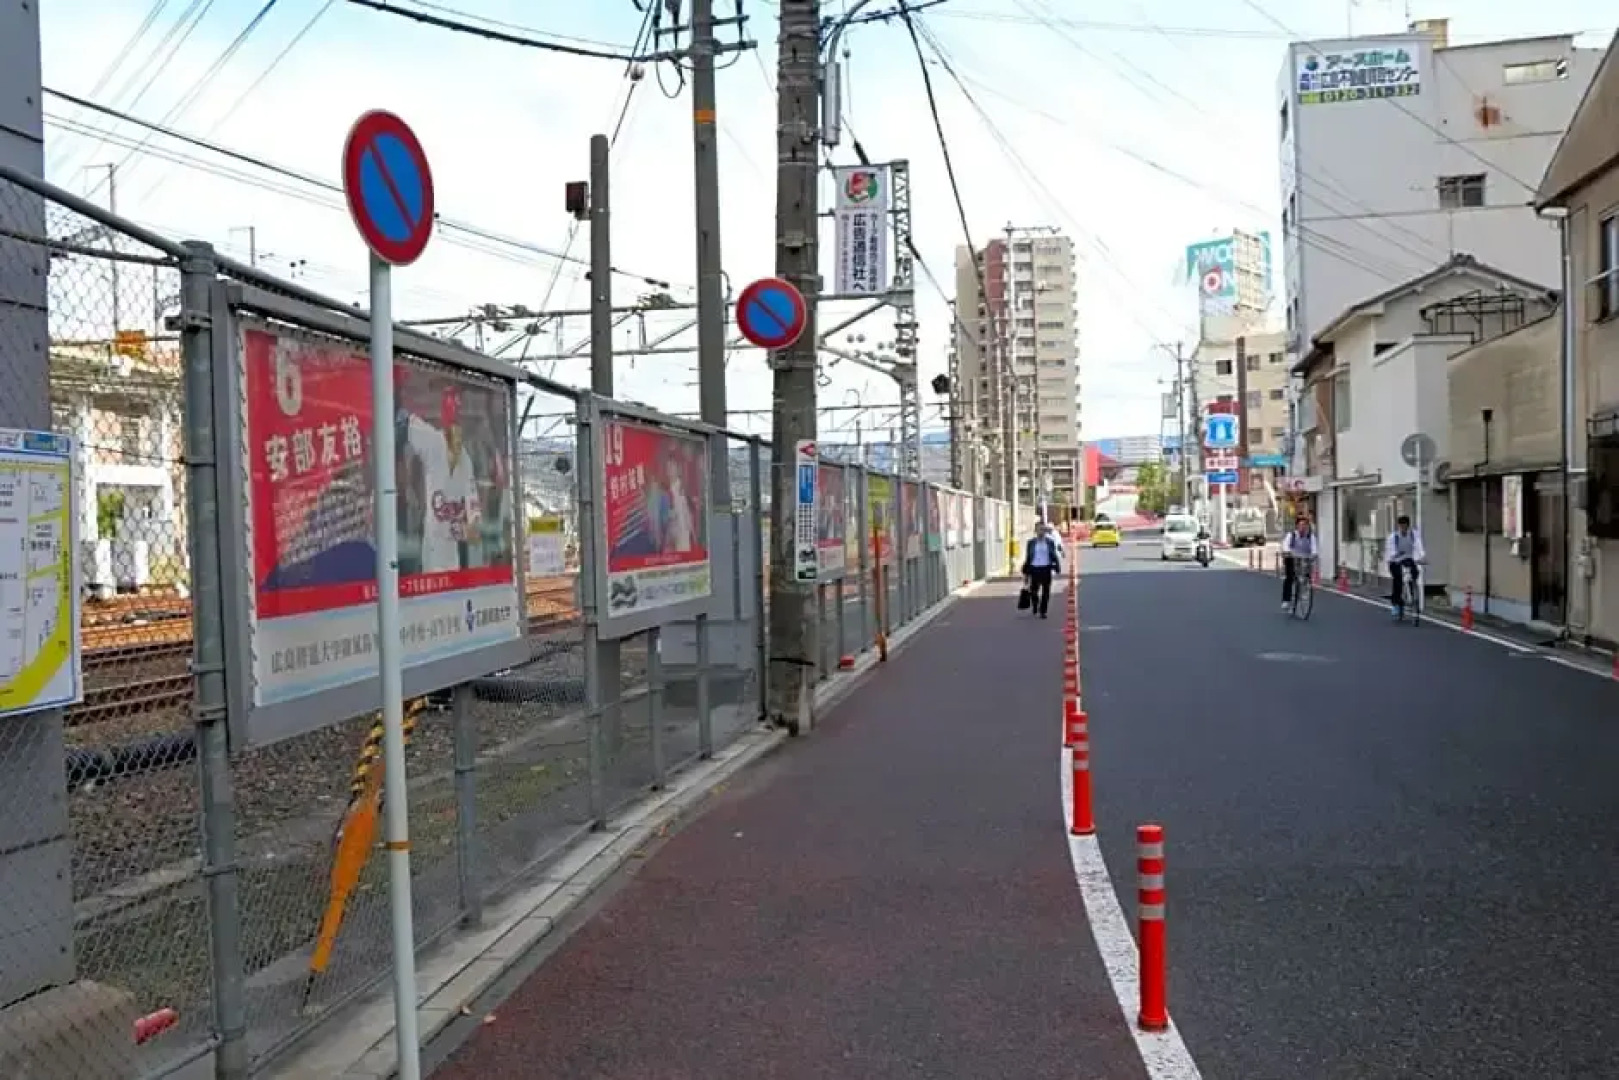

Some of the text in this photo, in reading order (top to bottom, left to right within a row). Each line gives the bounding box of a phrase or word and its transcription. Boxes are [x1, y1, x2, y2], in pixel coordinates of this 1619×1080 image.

[276, 337, 303, 416] 6
[264, 415, 362, 481] 安部友裕
